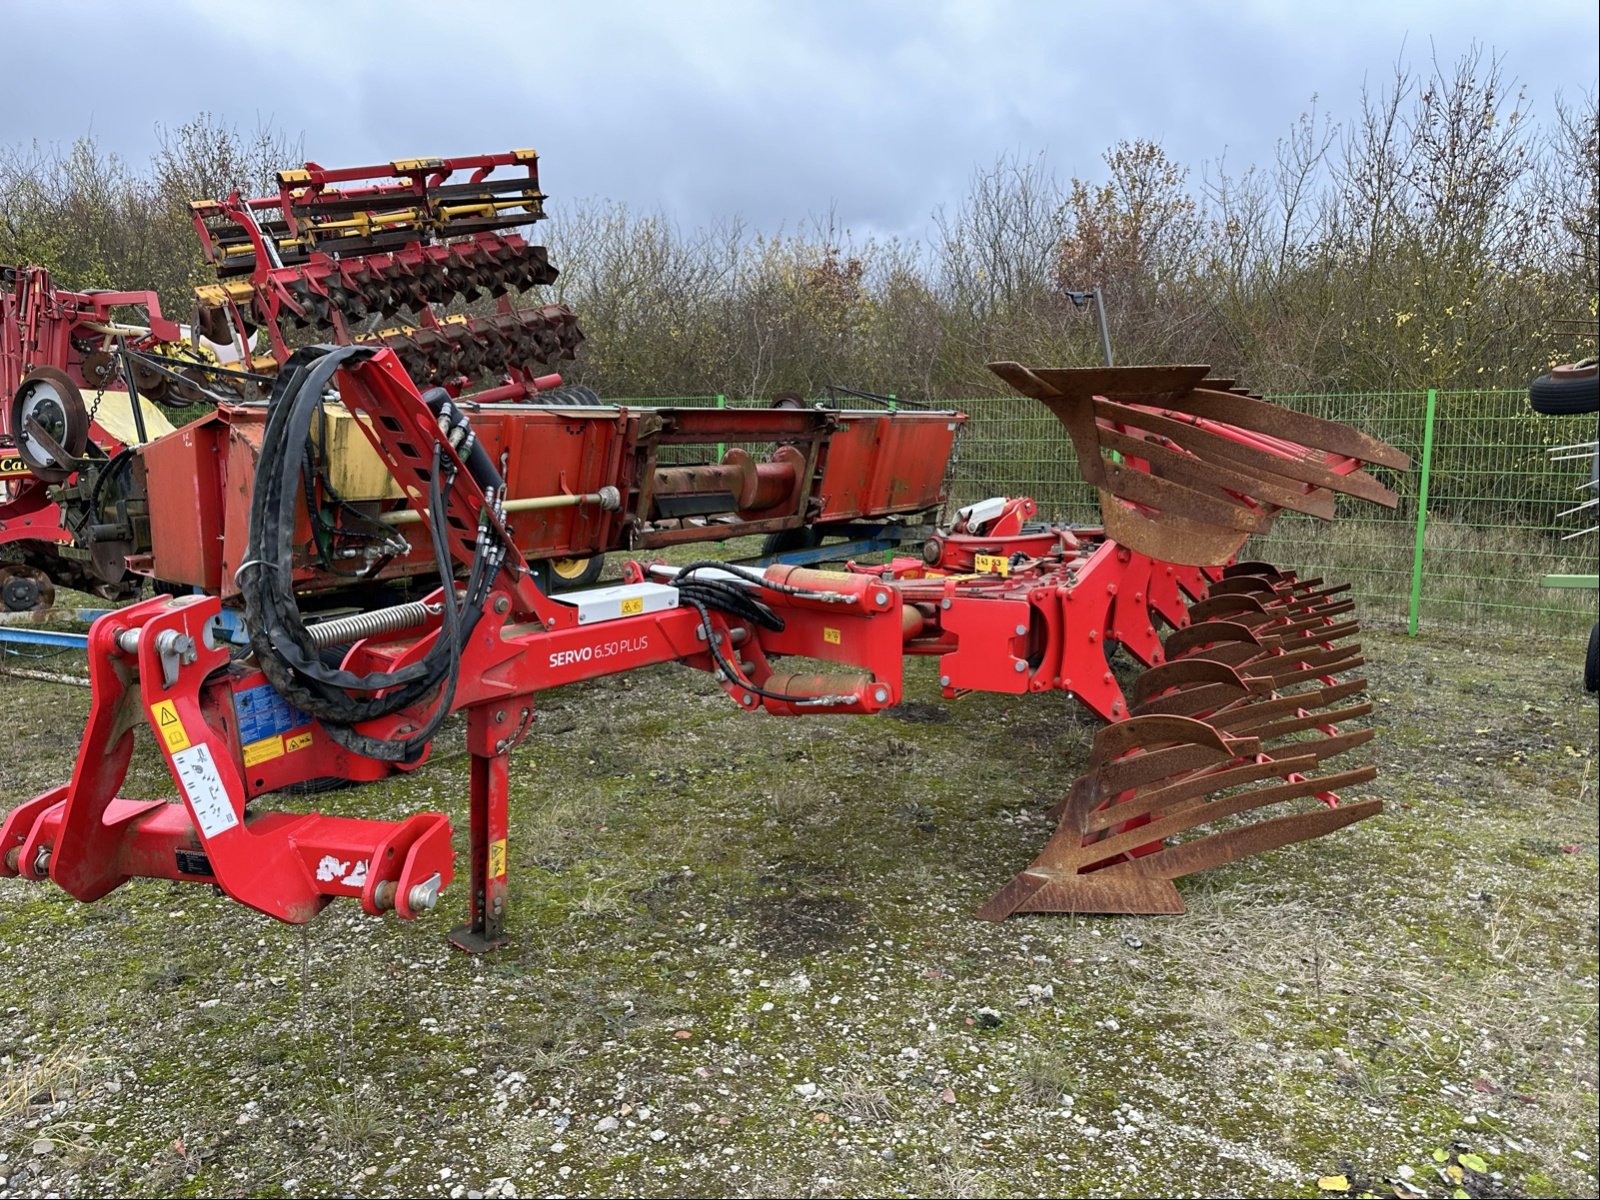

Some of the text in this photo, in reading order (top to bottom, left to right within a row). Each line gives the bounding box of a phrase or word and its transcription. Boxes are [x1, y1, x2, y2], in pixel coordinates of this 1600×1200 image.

[549, 635, 648, 668] SERVO 6.50 PLUS
